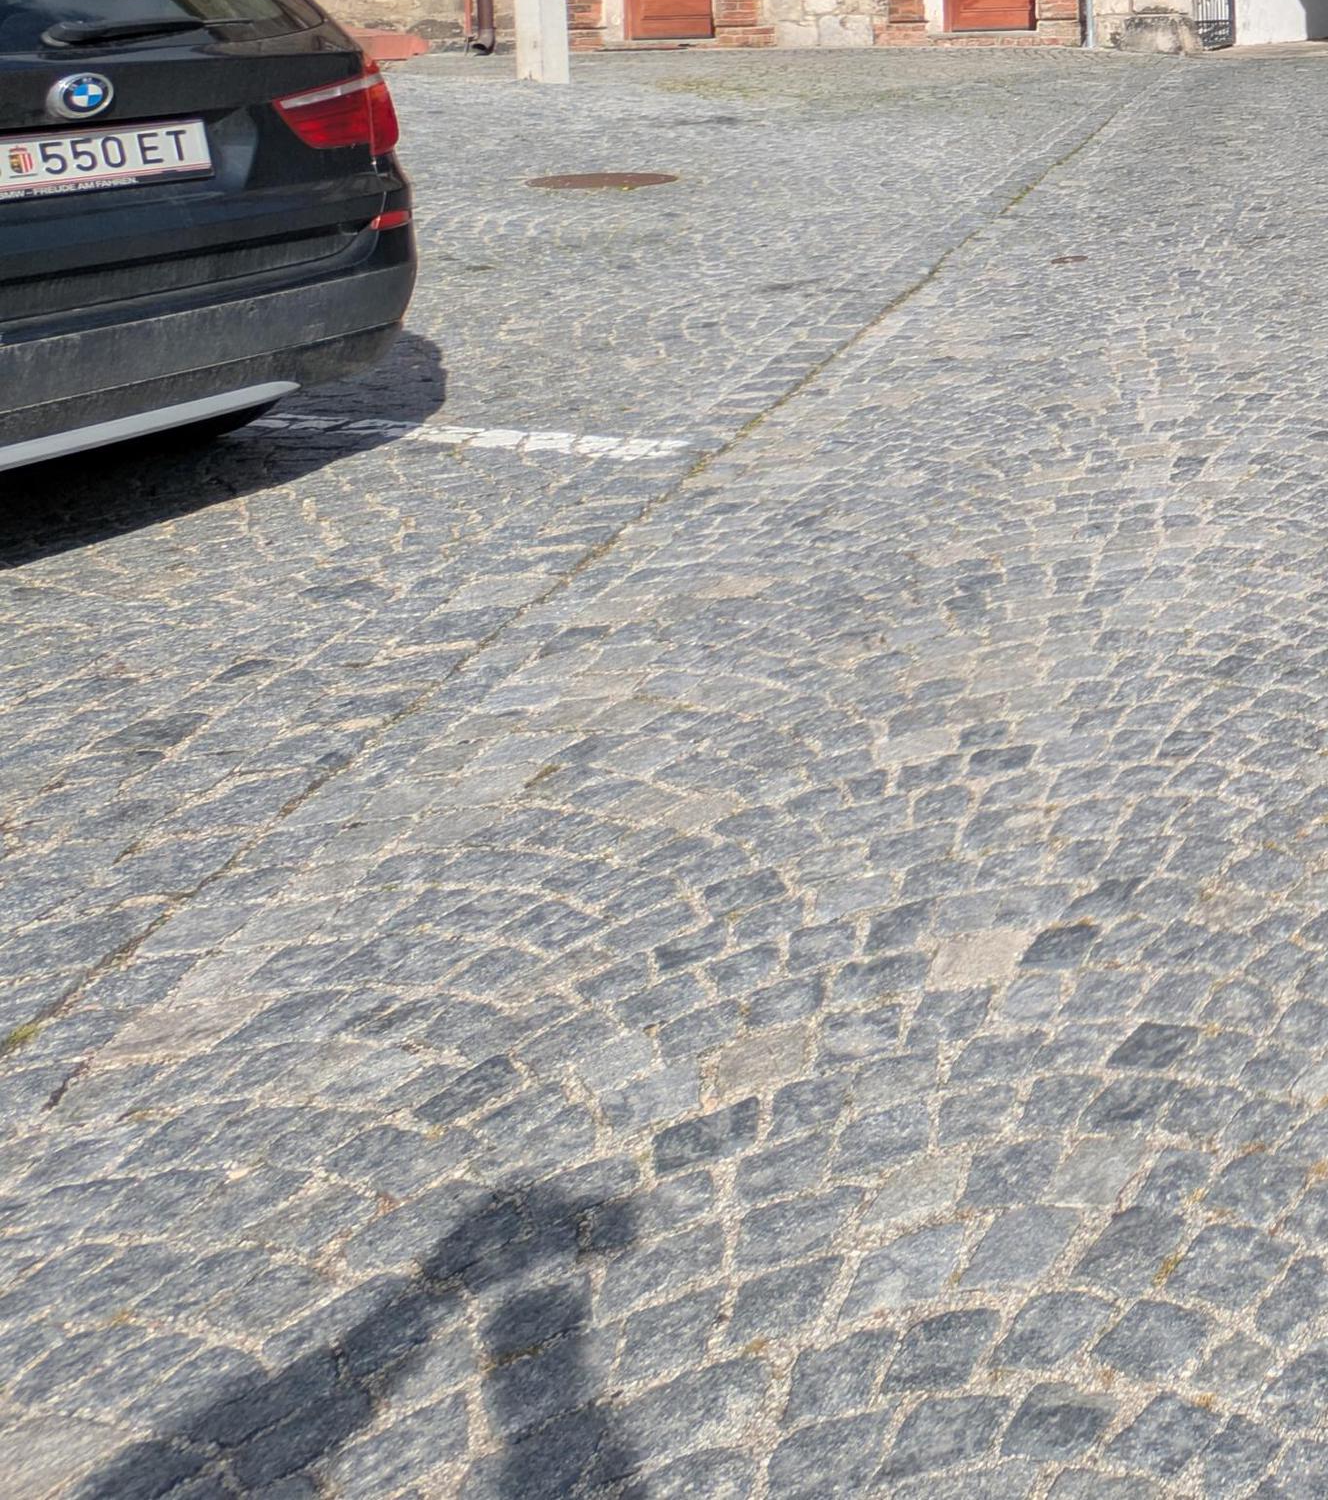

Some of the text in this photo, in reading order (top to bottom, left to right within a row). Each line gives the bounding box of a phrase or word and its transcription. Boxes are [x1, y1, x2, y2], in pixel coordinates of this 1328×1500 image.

[38, 129, 187, 175] 550 ET
[34, 184, 78, 195] FREUDE
[78, 181, 95, 190] AM
